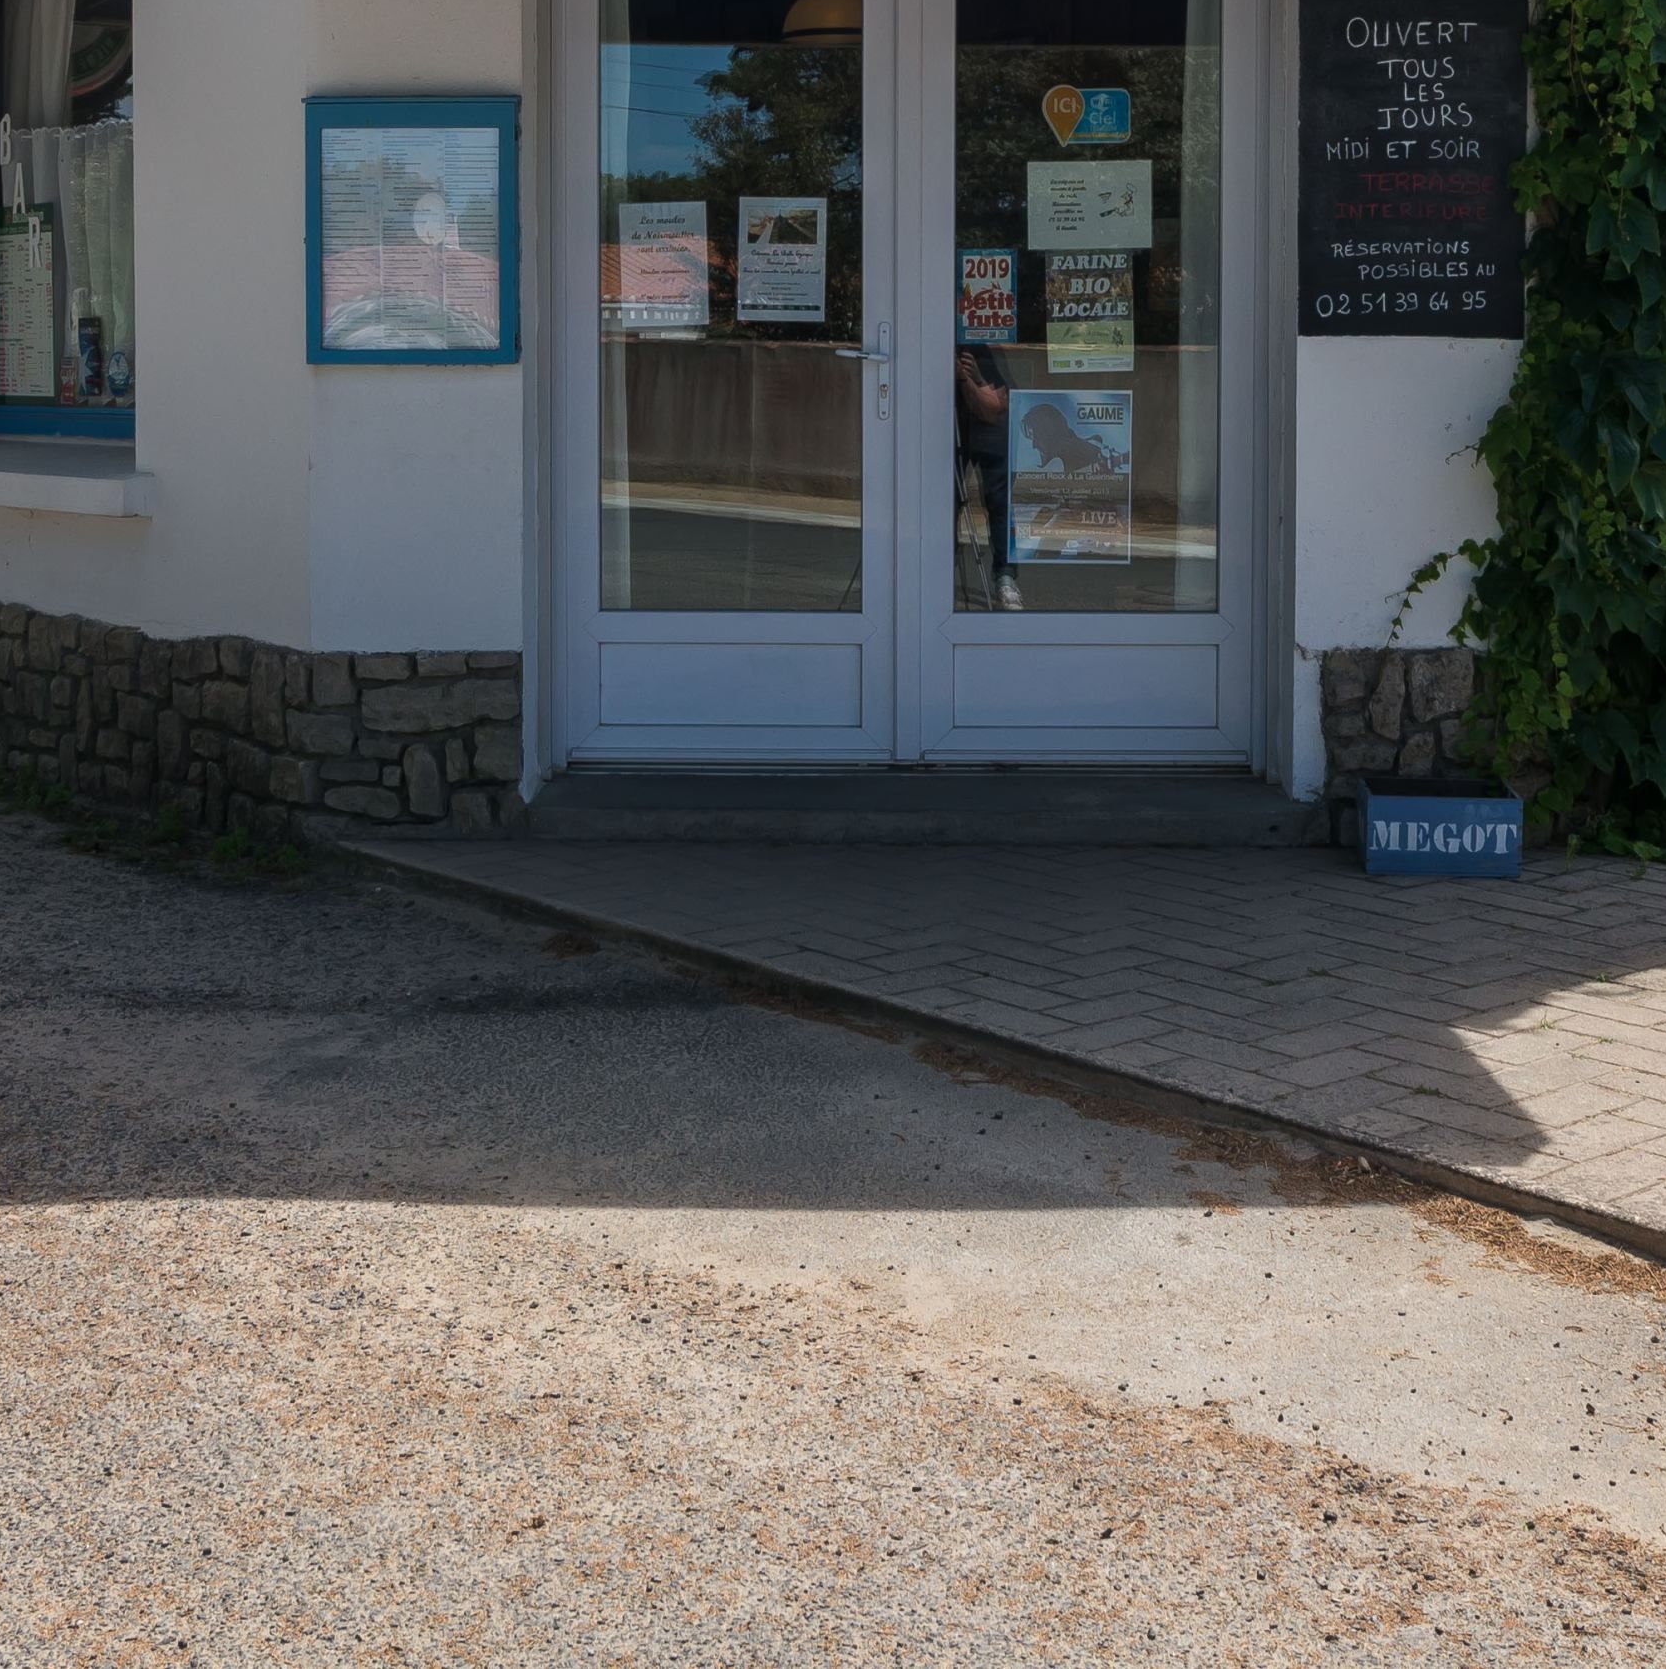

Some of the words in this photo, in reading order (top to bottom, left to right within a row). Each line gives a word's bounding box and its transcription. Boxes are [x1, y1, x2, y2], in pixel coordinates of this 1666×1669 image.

[1346, 16, 1478, 48] OUVERT
[1376, 57, 1455, 79] TOUS
[1404, 82, 1445, 102] LES
[1053, 97, 1077, 113] ICI
[1377, 103, 1473, 130] JOURS
[1386, 140, 1417, 159] ET
[1359, 171, 1496, 195] TERRASSE
[965, 258, 1010, 279] 2019
[1052, 254, 1127, 270] FARINE
[1476, 264, 1495, 276] AU
[1069, 277, 1111, 295] BIO
[1052, 302, 1129, 318] LOCALE
[1316, 293, 1351, 318] 02
[1361, 292, 1387, 314] 51
[1394, 292, 1418, 312] 39
[1429, 291, 1449, 311] 64
[1462, 290, 1487, 310] 95
[1077, 407, 1124, 421] GAUME
[1081, 511, 1117, 524] LIVE
[1369, 820, 1517, 854] MEGOT
